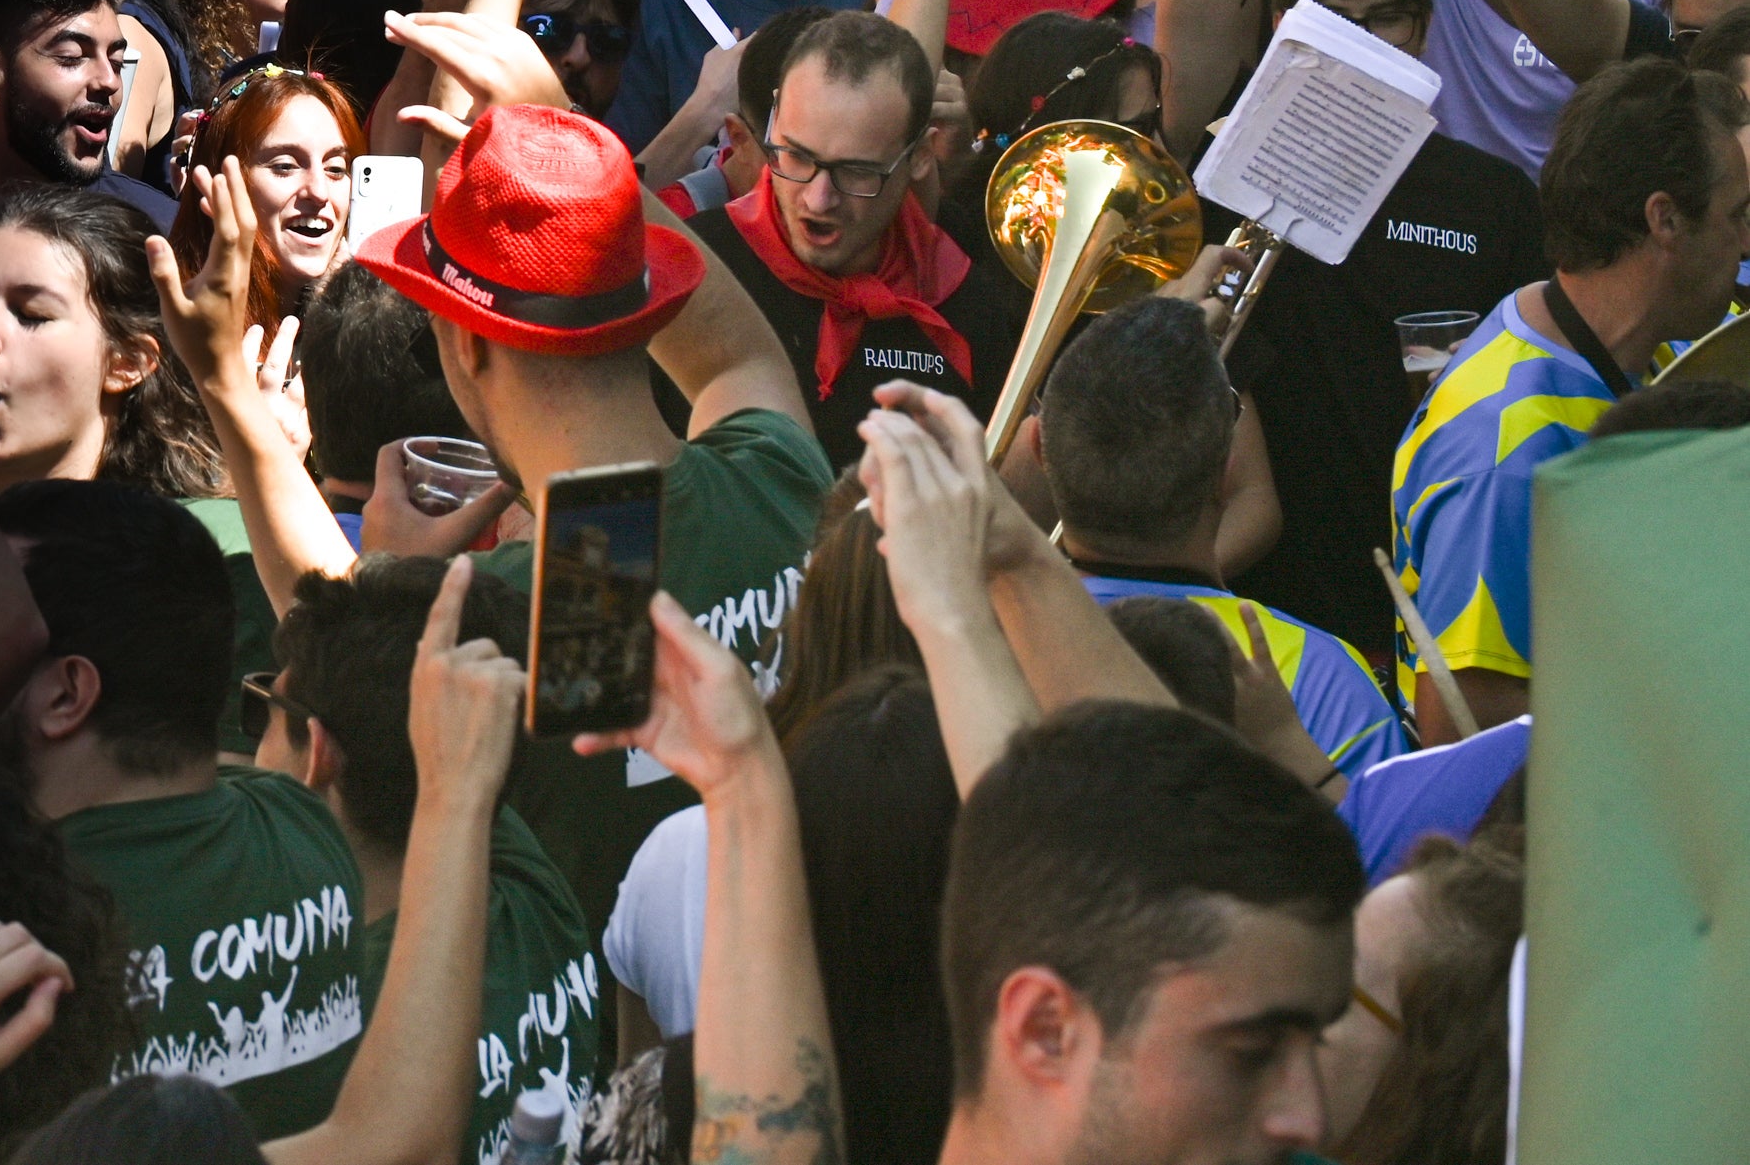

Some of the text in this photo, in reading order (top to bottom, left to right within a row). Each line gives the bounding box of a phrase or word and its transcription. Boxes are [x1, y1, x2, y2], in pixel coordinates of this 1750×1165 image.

[1386, 219, 1477, 254] MINITHOUS
[442, 263, 494, 307] Mahou
[864, 347, 944, 375] RAULITUPS
[191, 884, 353, 983] COMUNA
[479, 1033, 514, 1099] LA
